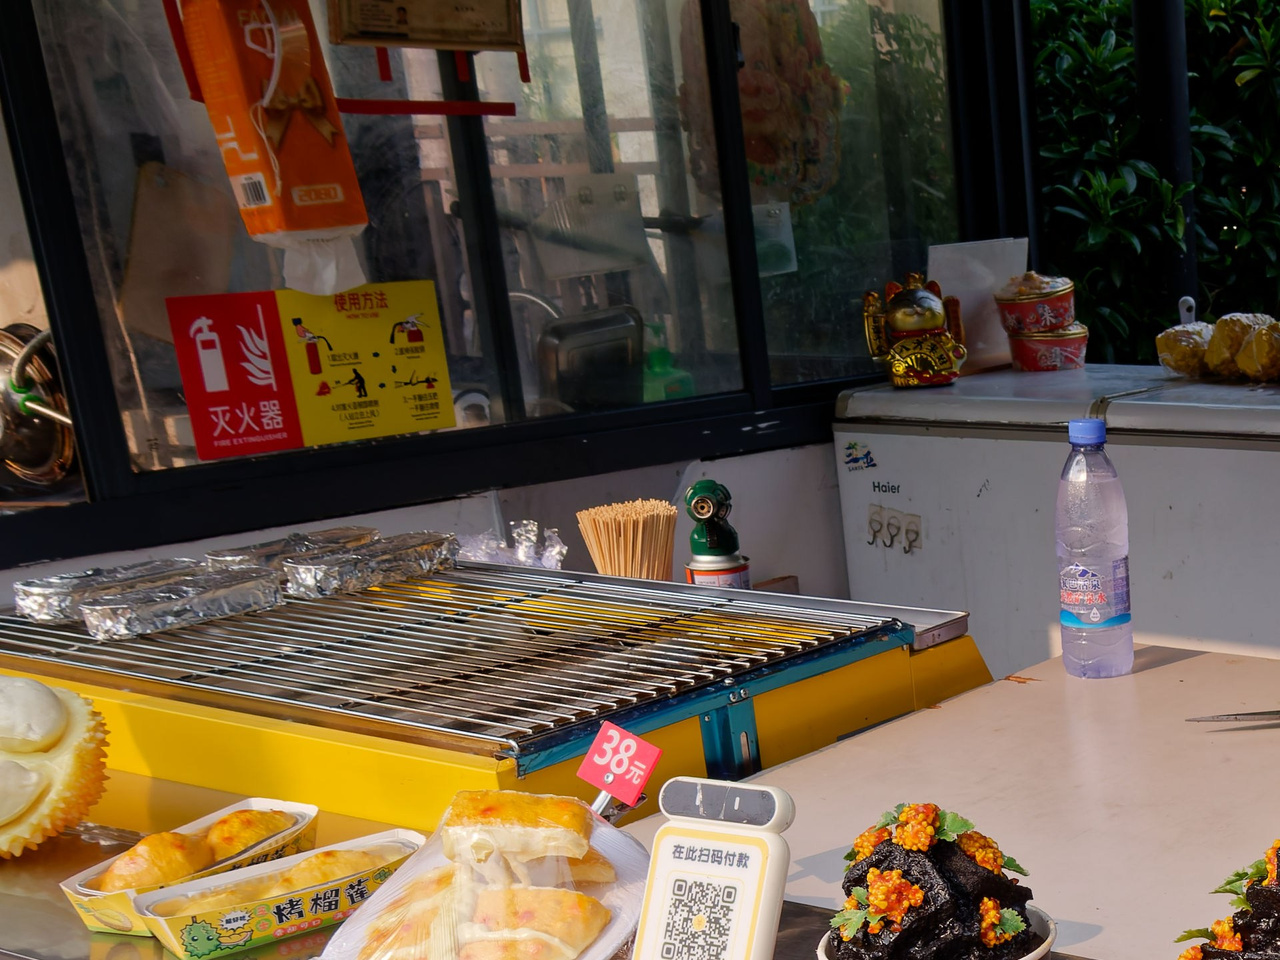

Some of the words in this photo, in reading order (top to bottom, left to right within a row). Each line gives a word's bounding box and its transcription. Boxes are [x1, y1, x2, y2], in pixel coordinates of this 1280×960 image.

[334, 290, 389, 312] 使用方法
[208, 399, 285, 438] 灭火器
[213, 439, 232, 447] FIRE
[232, 432, 288, 445] EXTINGUISHER
[872, 481, 900, 494] Haier
[593, 729, 646, 784] 38元
[672, 844, 750, 868] 在此扫码付款
[272, 877, 370, 923] 烤榴莲
